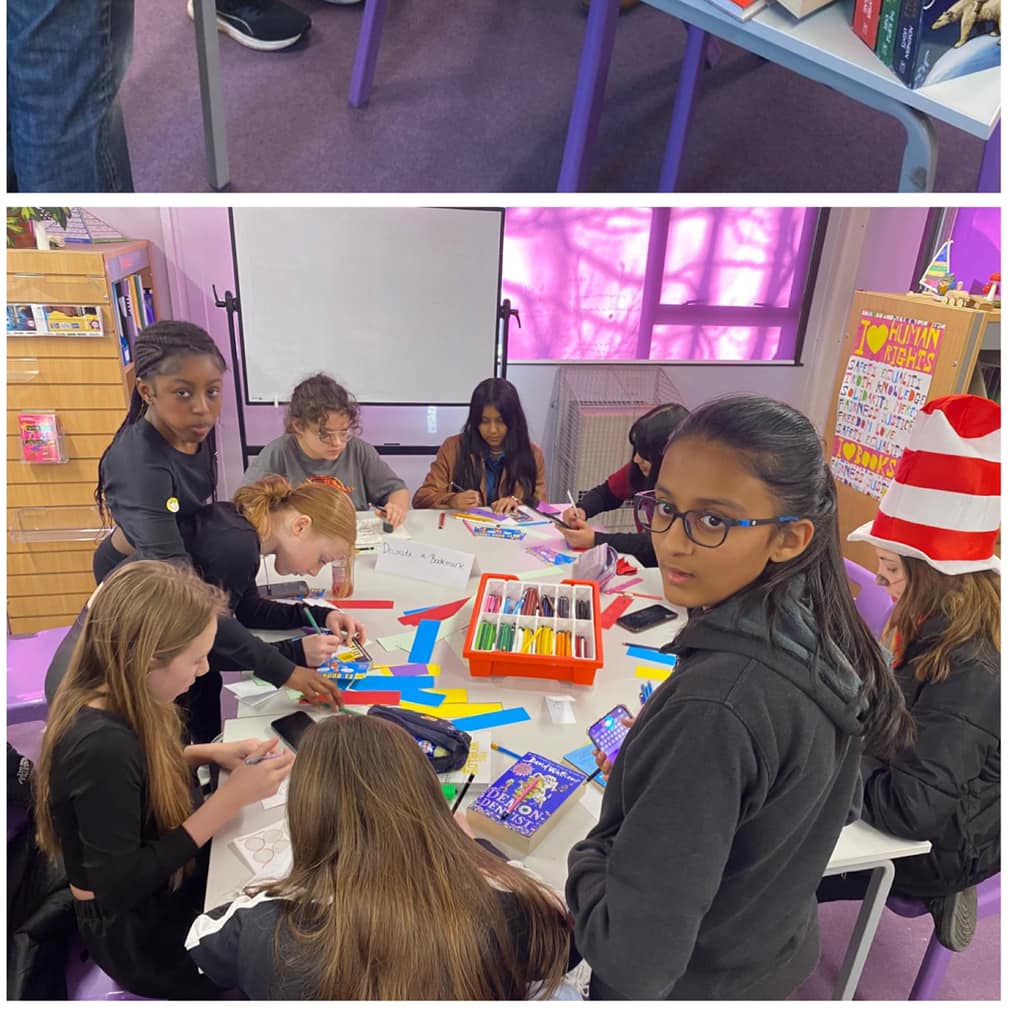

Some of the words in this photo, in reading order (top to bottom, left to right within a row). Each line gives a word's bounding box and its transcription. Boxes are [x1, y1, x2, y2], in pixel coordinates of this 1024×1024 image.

[854, 319, 871, 355] I
[888, 320, 941, 350] HUMAN
[884, 345, 935, 372] RIGHTS
[840, 385, 889, 411] SOLIDARITY
[876, 381, 927, 406] KNOWLEDGE
[839, 398, 879, 420] FAIRNESS
[836, 436, 844, 458] I
[854, 445, 897, 477] BOOKS
[523, 757, 549, 771] David
[480, 798, 532, 829] DENIST
